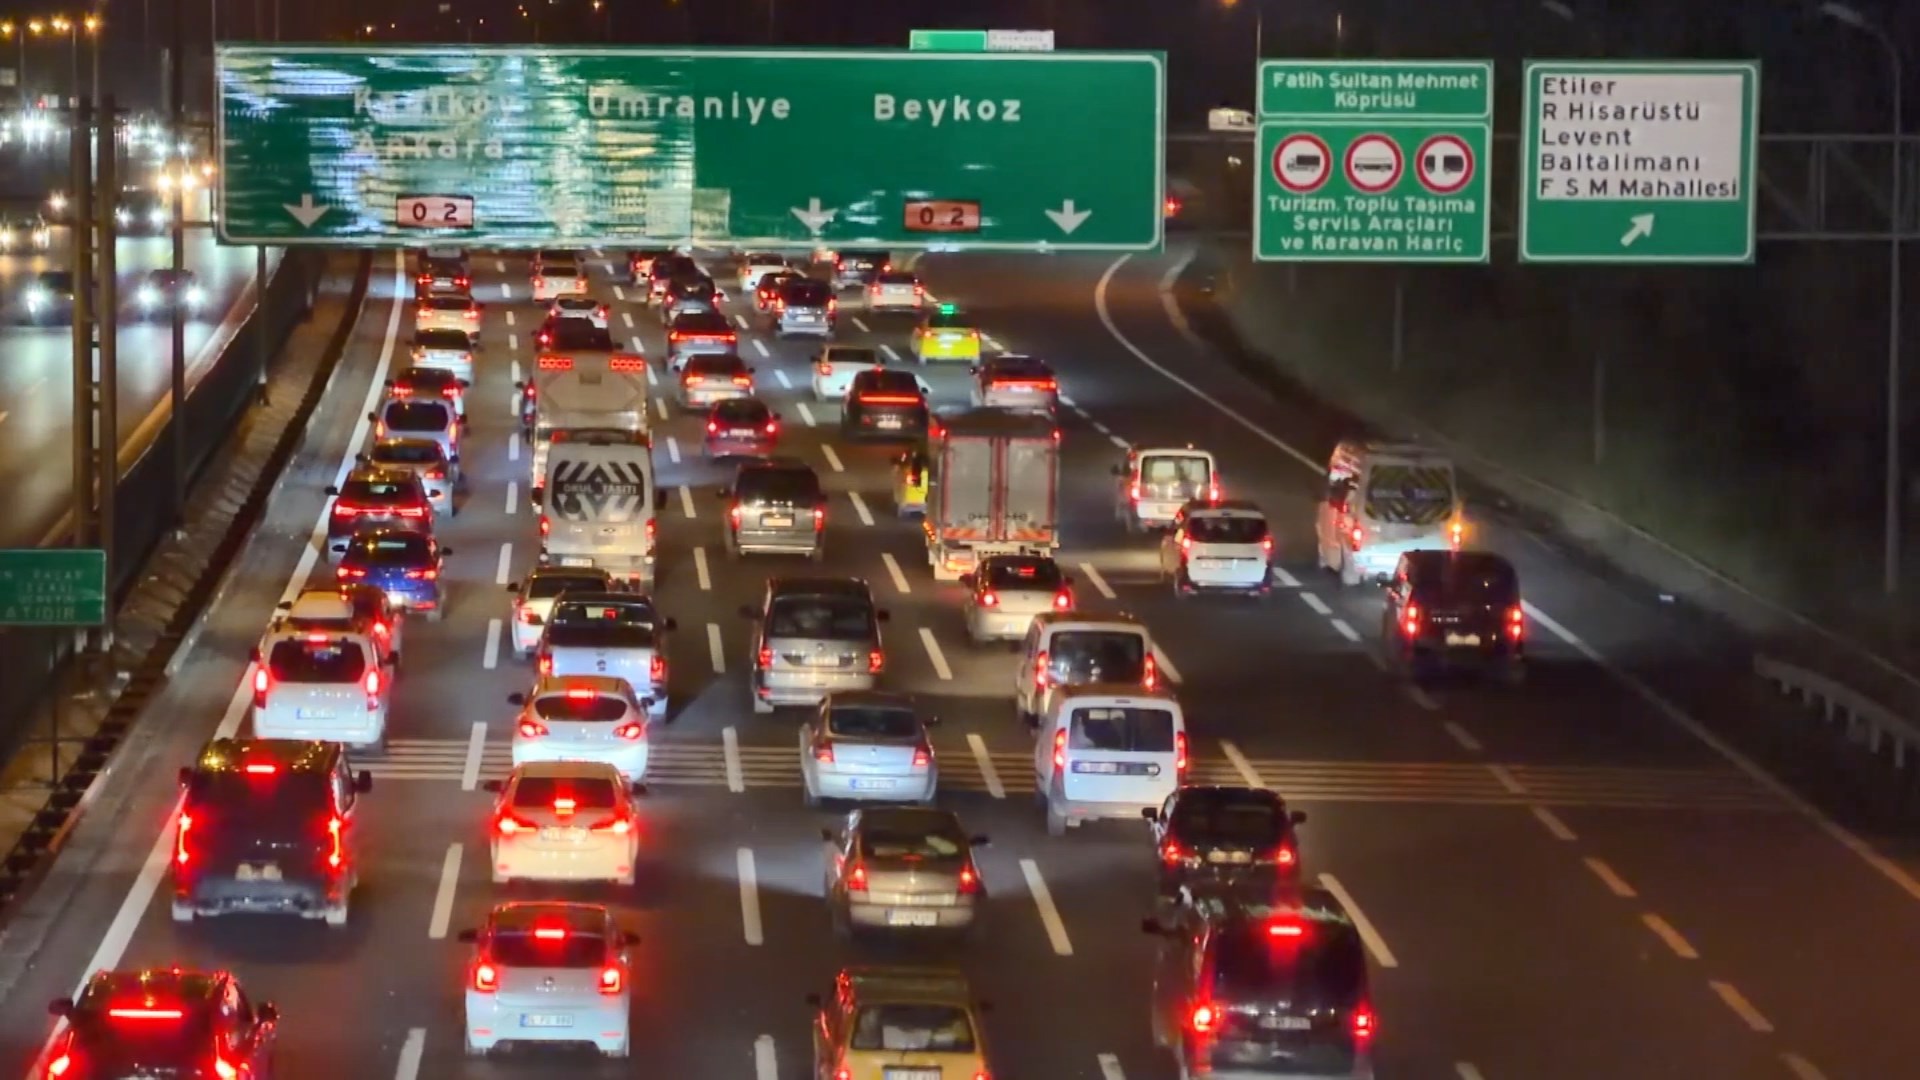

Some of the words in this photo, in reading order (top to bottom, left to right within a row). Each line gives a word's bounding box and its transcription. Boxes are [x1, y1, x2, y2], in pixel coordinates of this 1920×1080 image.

[1273, 72, 1323, 89] Fatih
[1328, 72, 1392, 89] Sultan
[1398, 72, 1479, 90] Mehmet
[1543, 77, 1617, 95] Etiler
[588, 88, 791, 126] Ümraniye
[874, 94, 1022, 127] Beykoz
[1335, 91, 1416, 111] Köprüsü
[1569, 101, 1700, 121] Hisarüstü
[356, 130, 504, 160] Ankara
[1542, 127, 1632, 146] Levent
[1541, 152, 1700, 172] Baltalimanı
[1619, 178, 1737, 197] Mahallesi
[1345, 196, 1399, 217] Toplu
[1405, 196, 1475, 214] Taşıma
[1293, 215, 1361, 232] Servis
[1368, 215, 1453, 234] Araçları
[1281, 237, 1304, 250] ve
[1312, 234, 1398, 250] Karavan
[1406, 234, 1463, 252] Hariç
